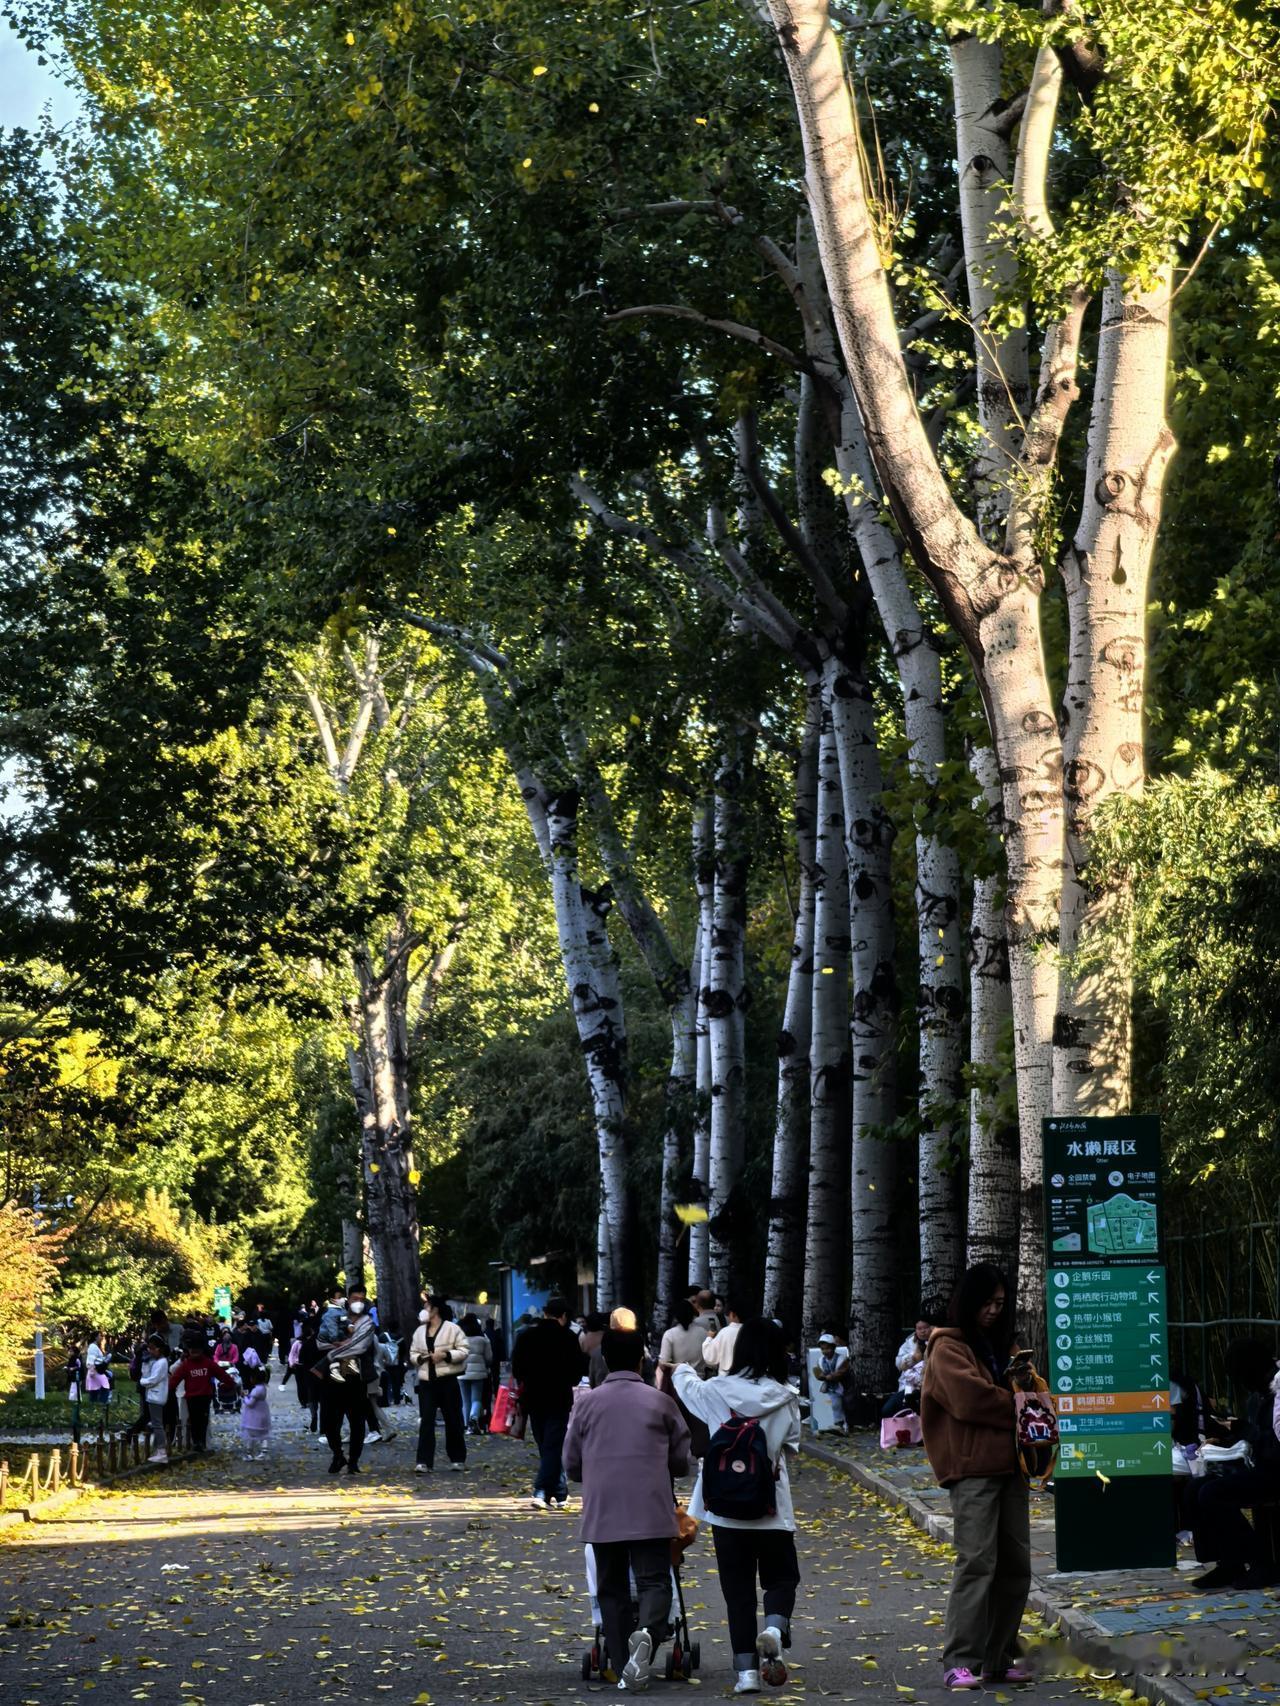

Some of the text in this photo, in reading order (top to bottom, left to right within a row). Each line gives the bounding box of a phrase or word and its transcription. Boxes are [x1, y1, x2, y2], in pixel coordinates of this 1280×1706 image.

[1066, 1139, 1137, 1157] 水獭展区
[1127, 1171, 1156, 1180] 电子地图
[1072, 1271, 1111, 1281] 企鹅乐园
[1072, 1291, 1138, 1302] 两栖爬行动物馆
[1074, 1312, 1122, 1323] 热带小猴馆
[1074, 1333, 1113, 1344] 金丝猴馆
[1075, 1354, 1114, 1365] 长颈鹿馆
[1075, 1375, 1114, 1386] 大熊猫馆
[1079, 1417, 1104, 1427] 卫生间
